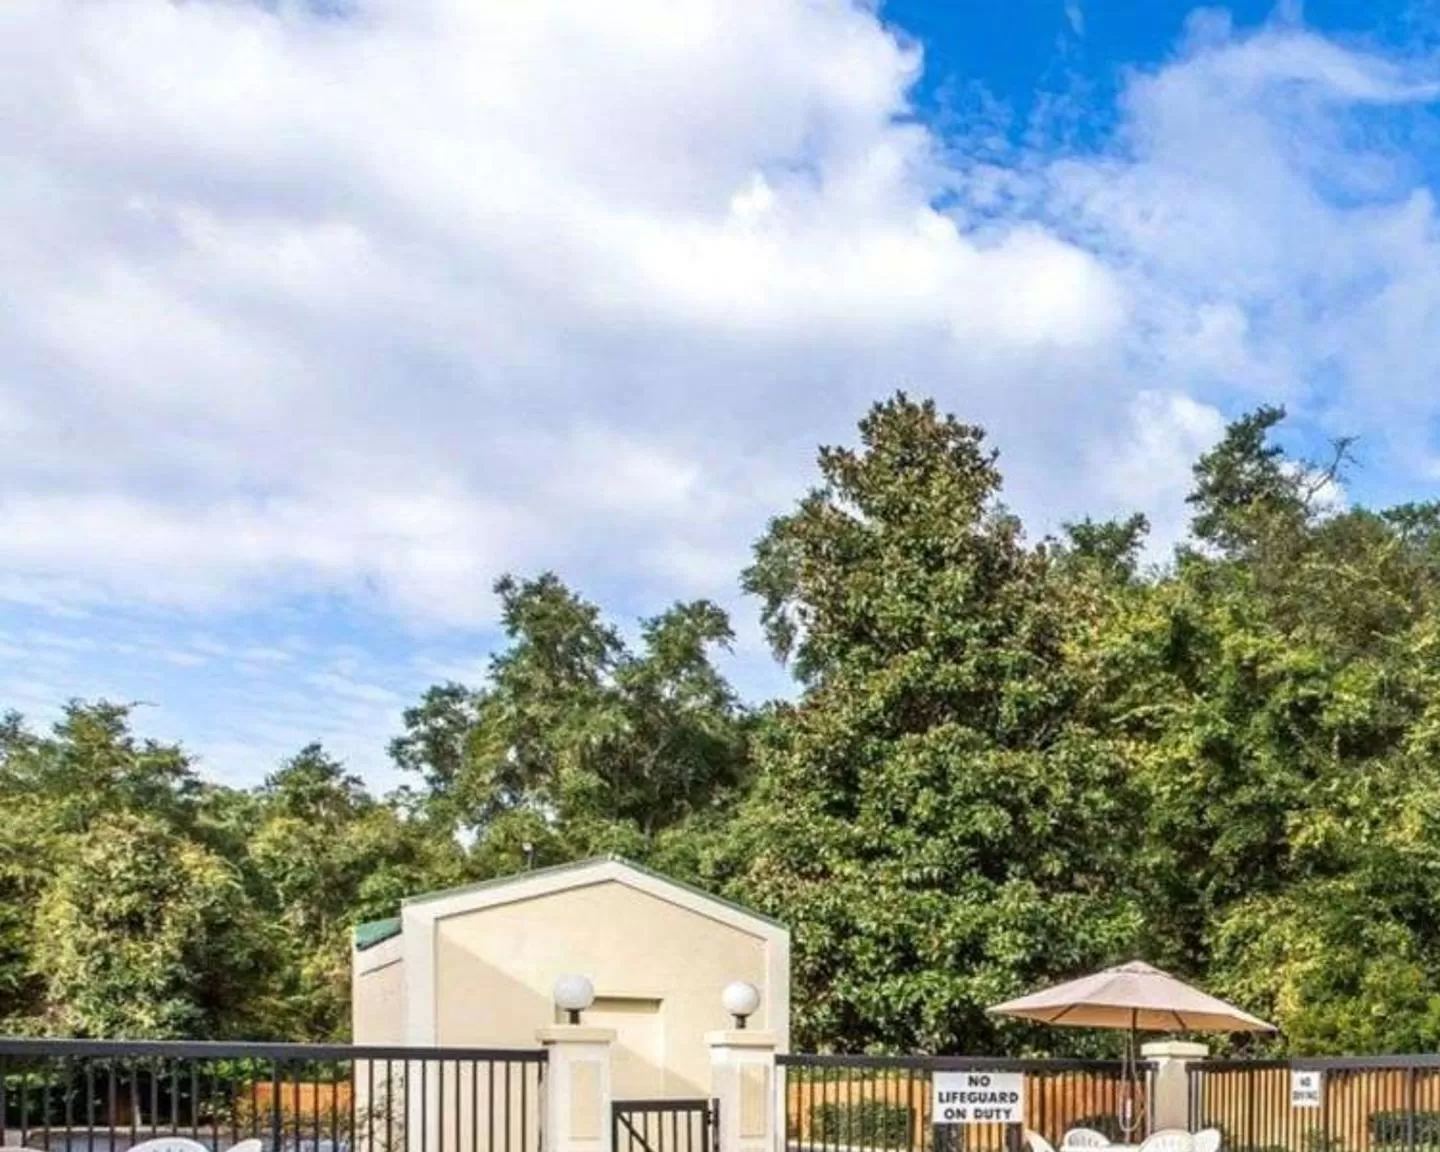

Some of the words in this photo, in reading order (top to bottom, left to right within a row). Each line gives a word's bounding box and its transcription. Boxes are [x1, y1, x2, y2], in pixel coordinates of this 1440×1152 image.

[968, 1075, 991, 1087] NO
[938, 1092, 1019, 1104] LIFEGUARD
[944, 1108, 967, 1120] ON
[974, 1109, 1012, 1120] DUTY
